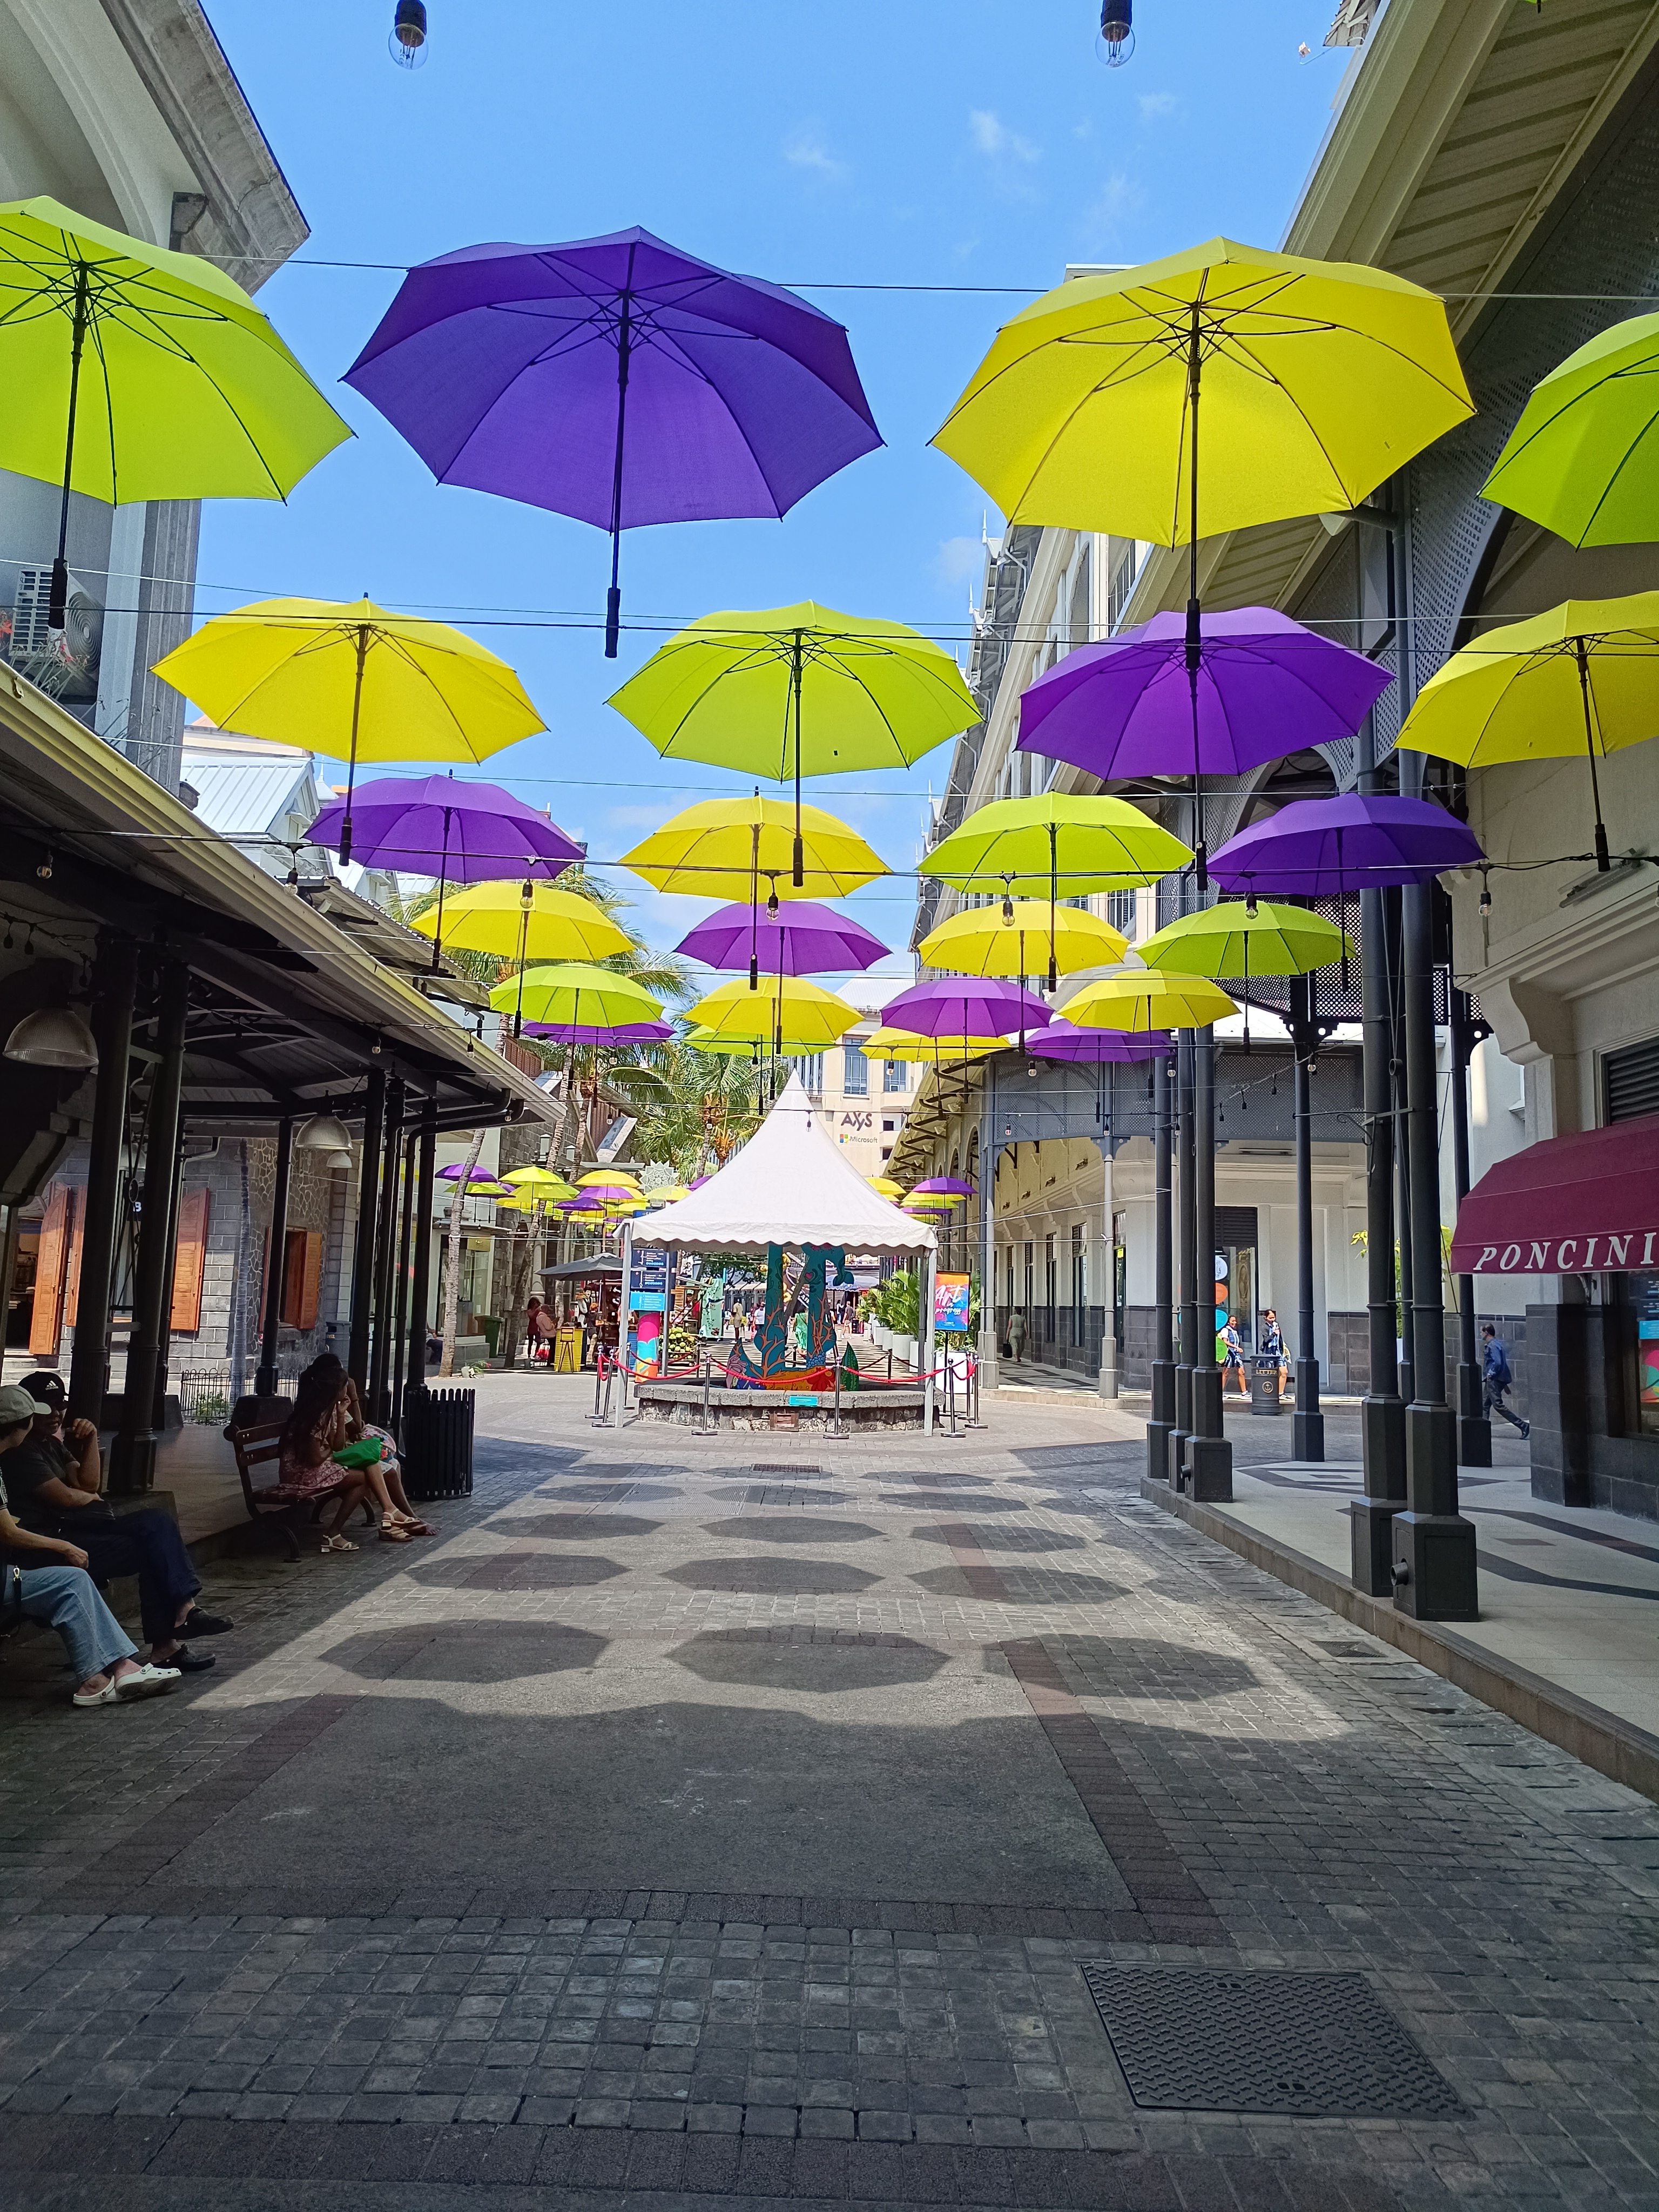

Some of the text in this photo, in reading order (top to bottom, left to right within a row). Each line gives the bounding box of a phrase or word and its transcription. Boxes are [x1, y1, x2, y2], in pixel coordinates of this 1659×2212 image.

[1473, 1232, 1657, 1271] PONCINI
[935, 1285, 966, 1307] Art
[935, 1307, 962, 1316] progress
